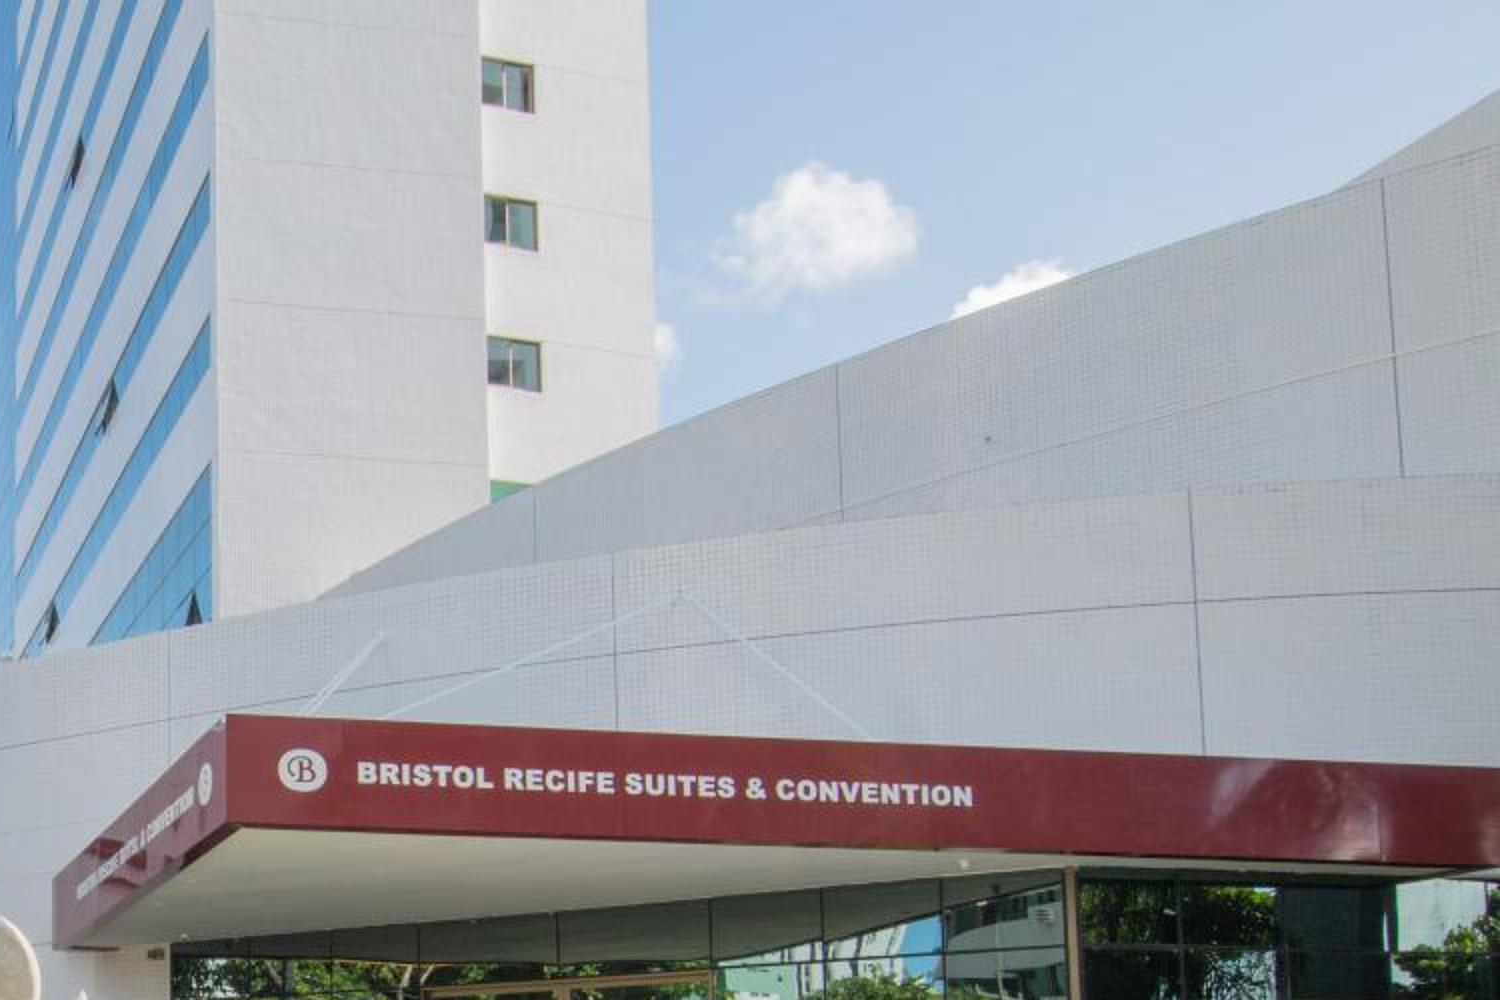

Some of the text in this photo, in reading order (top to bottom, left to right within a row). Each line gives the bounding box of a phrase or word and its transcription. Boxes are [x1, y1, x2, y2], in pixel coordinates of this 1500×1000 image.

[357, 761, 973, 807] BRISTOL RECIFE SUITES & CONVENTION
